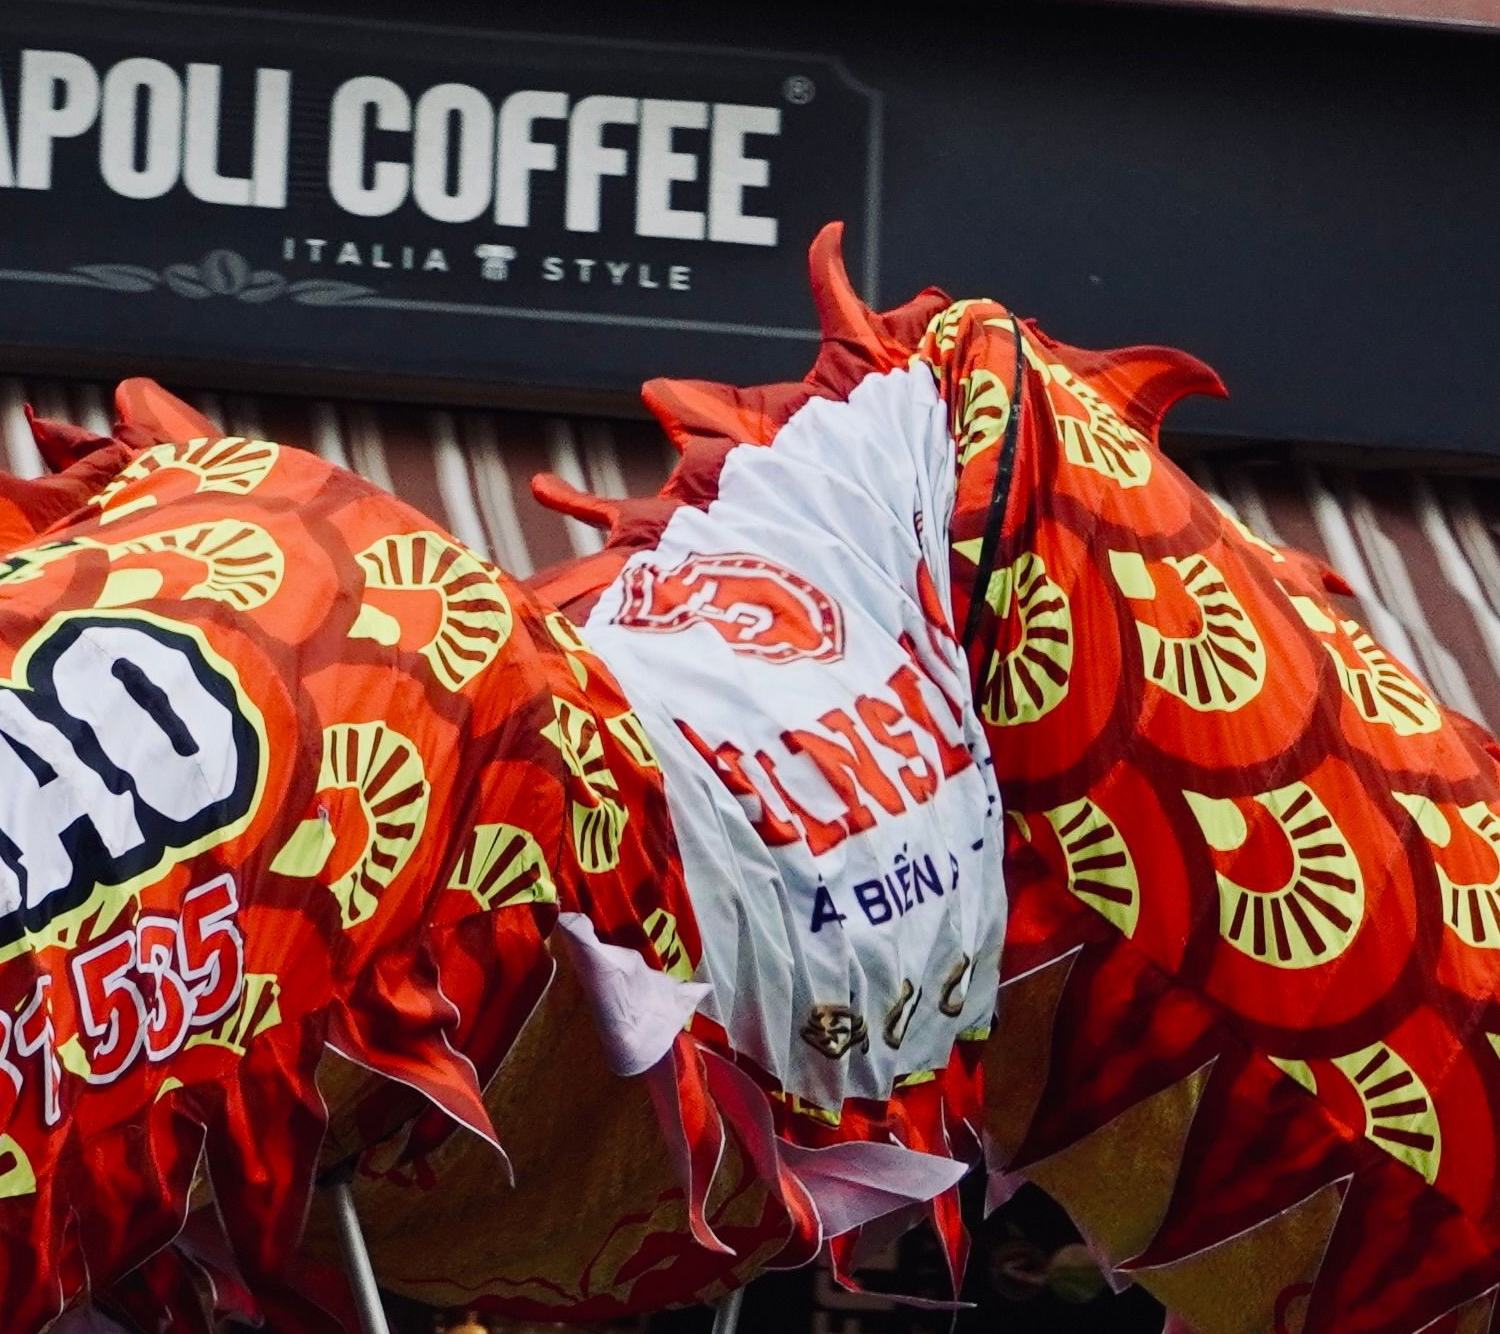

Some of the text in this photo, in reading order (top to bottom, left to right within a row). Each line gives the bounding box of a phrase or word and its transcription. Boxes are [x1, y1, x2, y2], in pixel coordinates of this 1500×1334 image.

[327, 74, 782, 245] COFFEE
[282, 237, 693, 293] ITALIA STYLE
